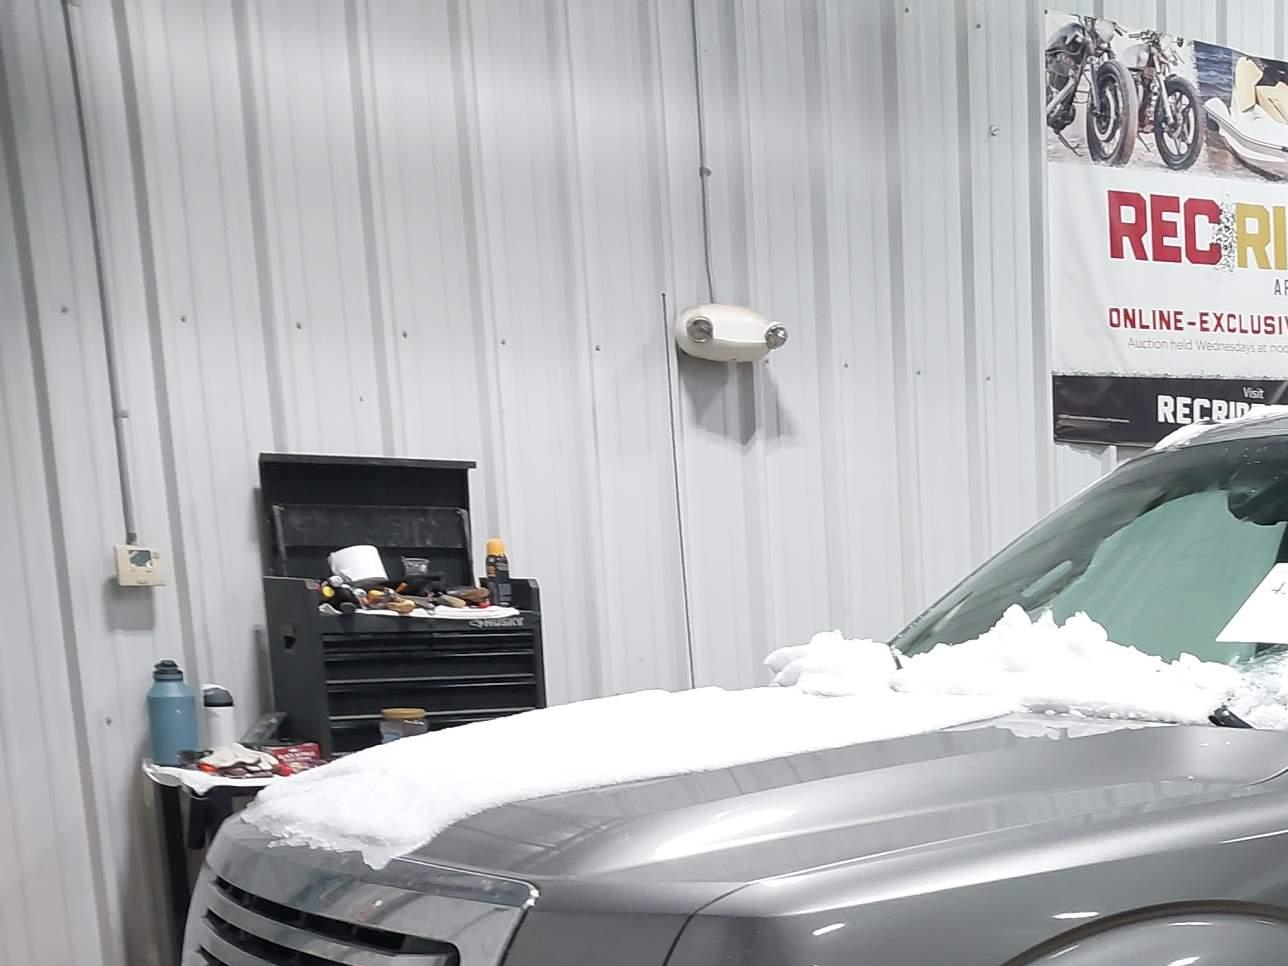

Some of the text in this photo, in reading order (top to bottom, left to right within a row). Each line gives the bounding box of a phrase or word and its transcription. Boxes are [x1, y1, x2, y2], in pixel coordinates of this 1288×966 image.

[1107, 190, 1222, 266] REC
[1274, 279, 1281, 295] A
[1128, 337, 1168, 350] Auction
[1171, 339, 1193, 351] held
[1196, 340, 1256, 354] Wednesdays
[1257, 344, 1267, 353] at
[1243, 386, 1264, 399] Visit
[1157, 394, 1253, 424] RECRID
